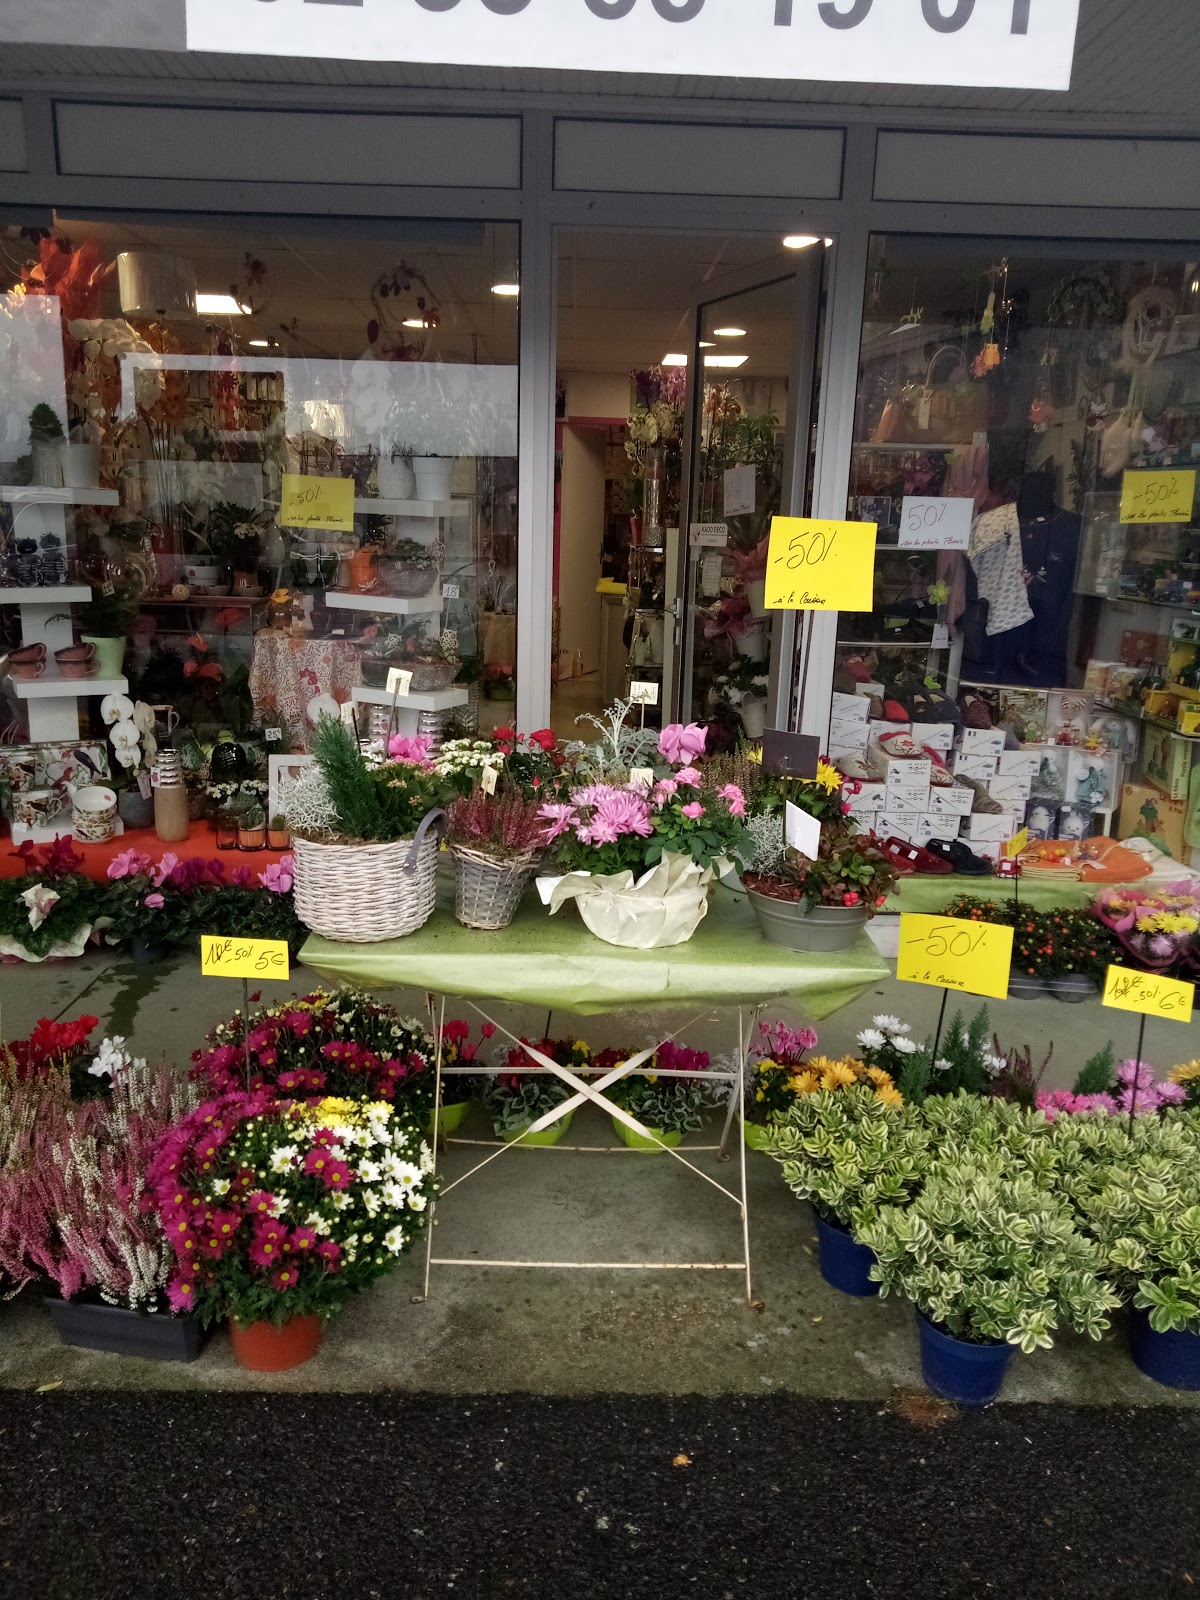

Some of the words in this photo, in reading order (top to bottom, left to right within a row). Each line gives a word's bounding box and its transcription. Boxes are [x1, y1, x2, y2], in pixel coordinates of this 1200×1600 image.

[774, 527, 838, 569] -50%
[906, 925, 988, 957] -50%
[255, 951, 285, 970] 5€
[1159, 991, 1186, 1009] 6€
